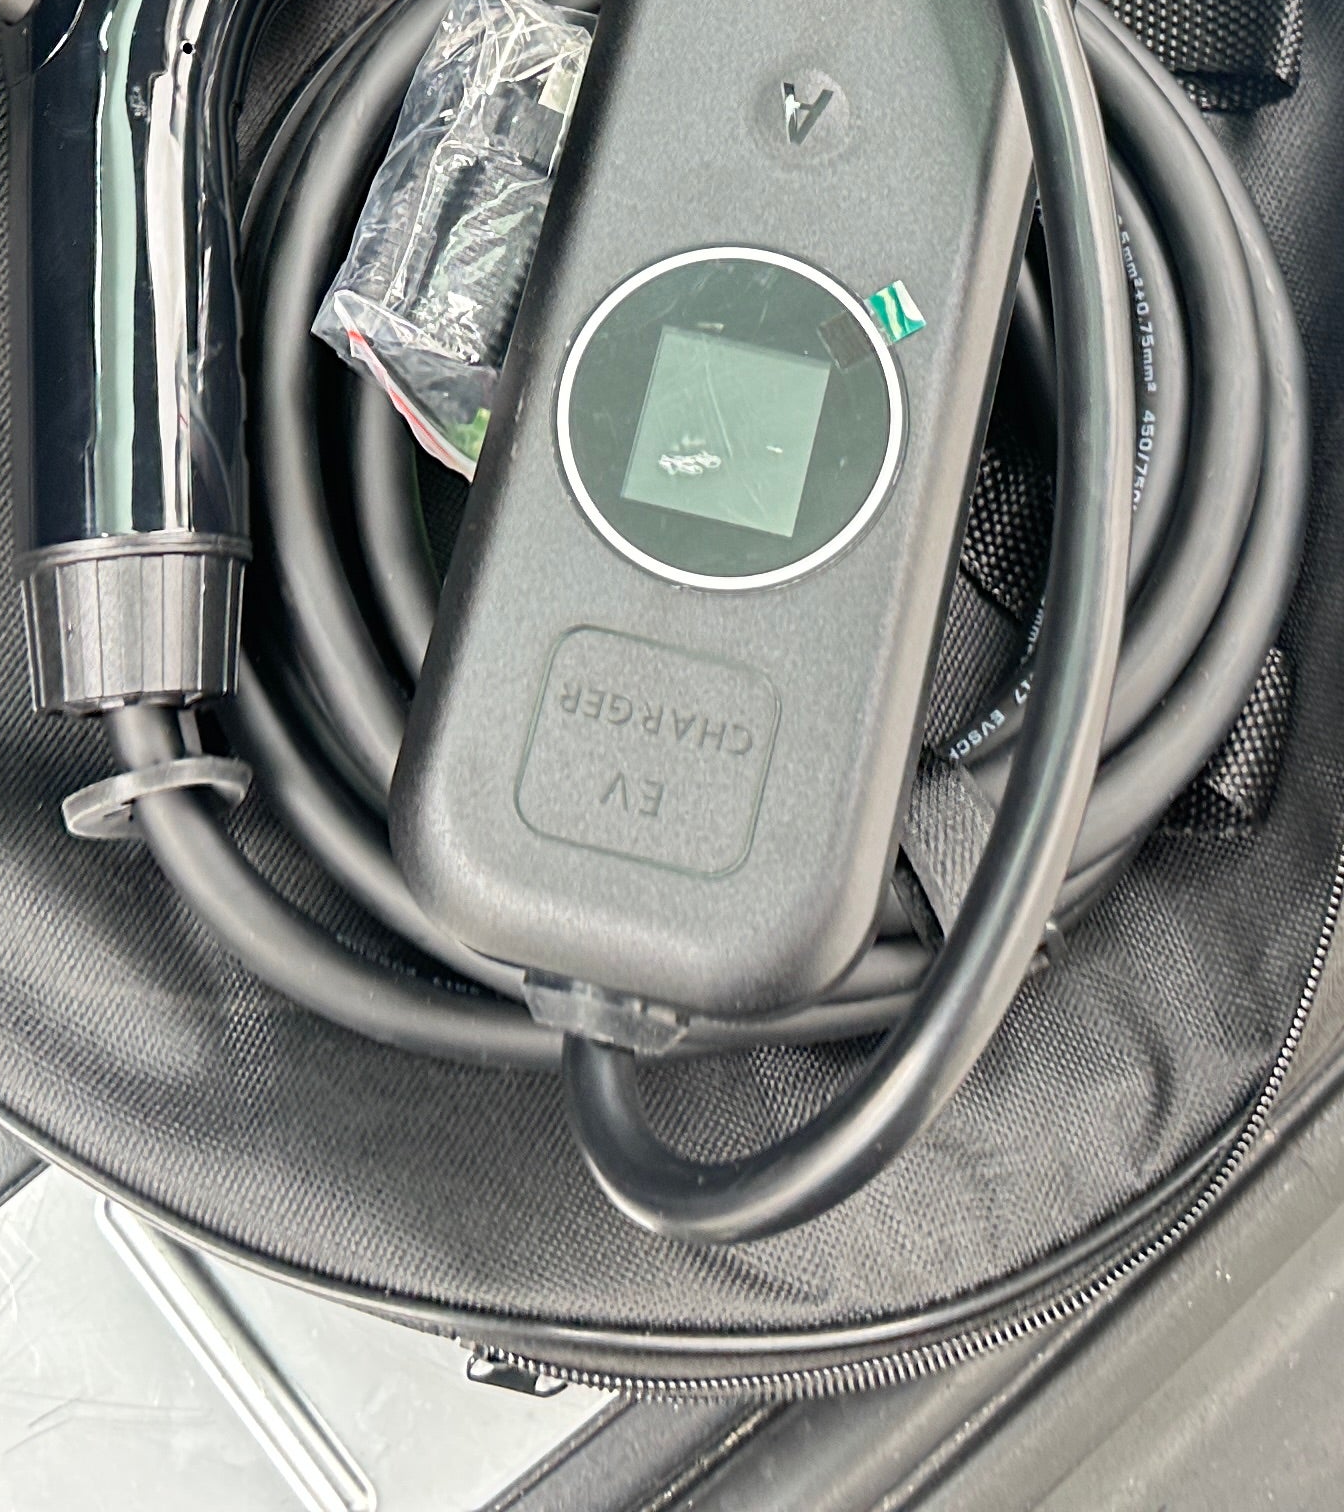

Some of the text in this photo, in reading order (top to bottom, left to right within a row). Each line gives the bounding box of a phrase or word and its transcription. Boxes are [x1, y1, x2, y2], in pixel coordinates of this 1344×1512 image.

[1133, 410, 1155, 510] 450/750
[559, 682, 753, 756] CHARGER
[599, 770, 666, 817] EV
